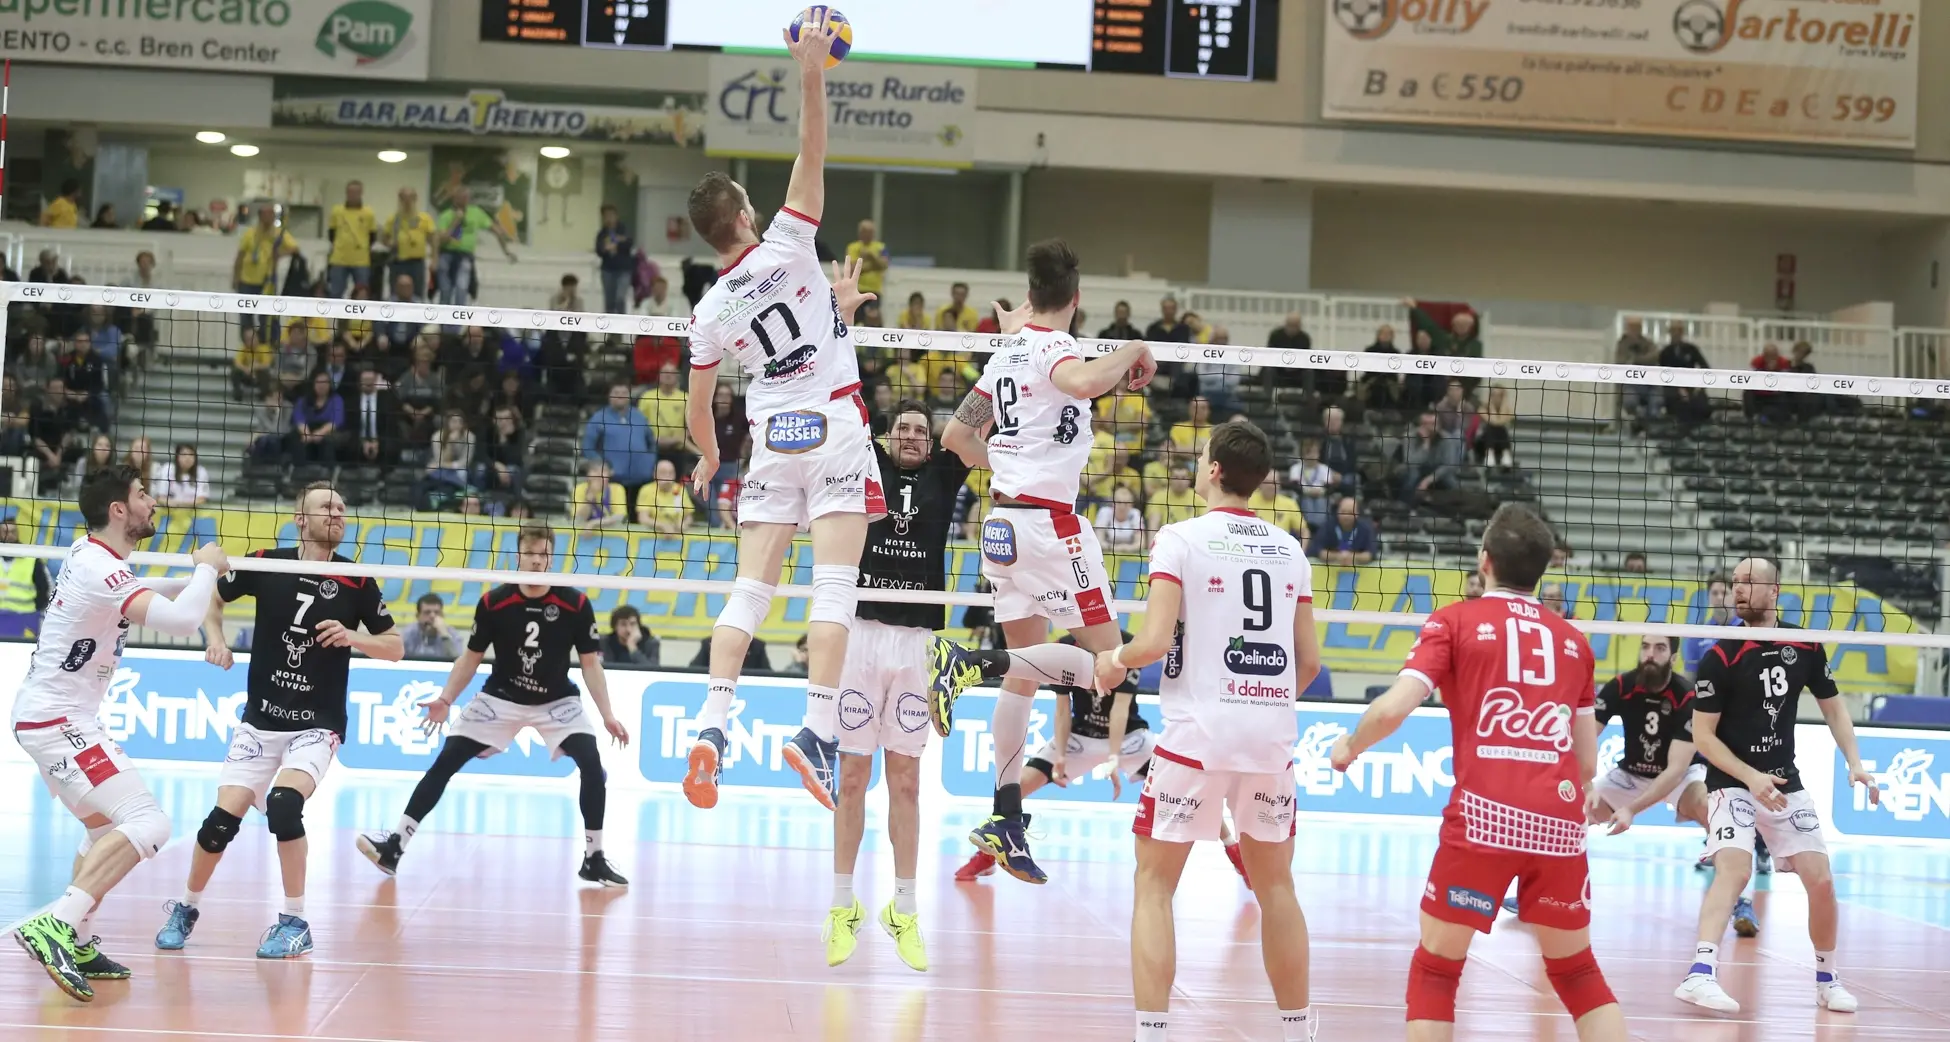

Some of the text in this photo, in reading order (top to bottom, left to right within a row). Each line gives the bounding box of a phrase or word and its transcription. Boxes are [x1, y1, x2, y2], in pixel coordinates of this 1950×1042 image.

[332, 16, 396, 44] Pam
[141, 36, 193, 59] Bren
[202, 40, 281, 63] Center
[1364, 69, 1387, 96] B
[824, 77, 965, 105] assa Rurale
[1665, 86, 1689, 112] C
[1699, 88, 1726, 114] D
[1734, 88, 1760, 116] E
[337, 99, 396, 121] BAR
[833, 101, 912, 129] Trento
[22, 287, 45, 298] CEV
[129, 292, 152, 303] CEV
[237, 299, 259, 309] CEV
[344, 304, 367, 314] CEV
[452, 310, 474, 320] CEV
[559, 316, 582, 326] CEV
[667, 322, 689, 332] CEV
[750, 302, 801, 358] 17
[882, 333, 904, 343] CEV
[1202, 349, 1225, 359] CEV
[1309, 354, 1332, 364] CEV
[1415, 360, 1437, 370] CEV
[1520, 365, 1542, 375] CEV
[1625, 370, 1647, 380] CEV
[1729, 375, 1751, 385] CEV
[1833, 380, 1855, 390] CEV
[769, 427, 821, 442] GASSER
[900, 485, 913, 513] 1
[1226, 522, 1269, 537] GIANNELLI
[885, 538, 917, 549] HOTEL
[983, 540, 1013, 556] GASSER
[872, 545, 926, 558] ELLIVUORI
[1230, 556, 1259, 565] COATING
[1260, 558, 1290, 567] COMPANY
[1242, 568, 1273, 632] 9
[292, 592, 315, 625] 7
[524, 621, 540, 648] 2
[1226, 649, 1285, 667] Melinda
[1505, 617, 1556, 686] 13
[276, 669, 308, 683] HOTEL
[1758, 665, 1789, 698] 13
[1238, 680, 1289, 698] dalmec
[268, 703, 300, 721] VEXVE
[1644, 711, 1660, 735] 3
[1715, 826, 1735, 841] 13
